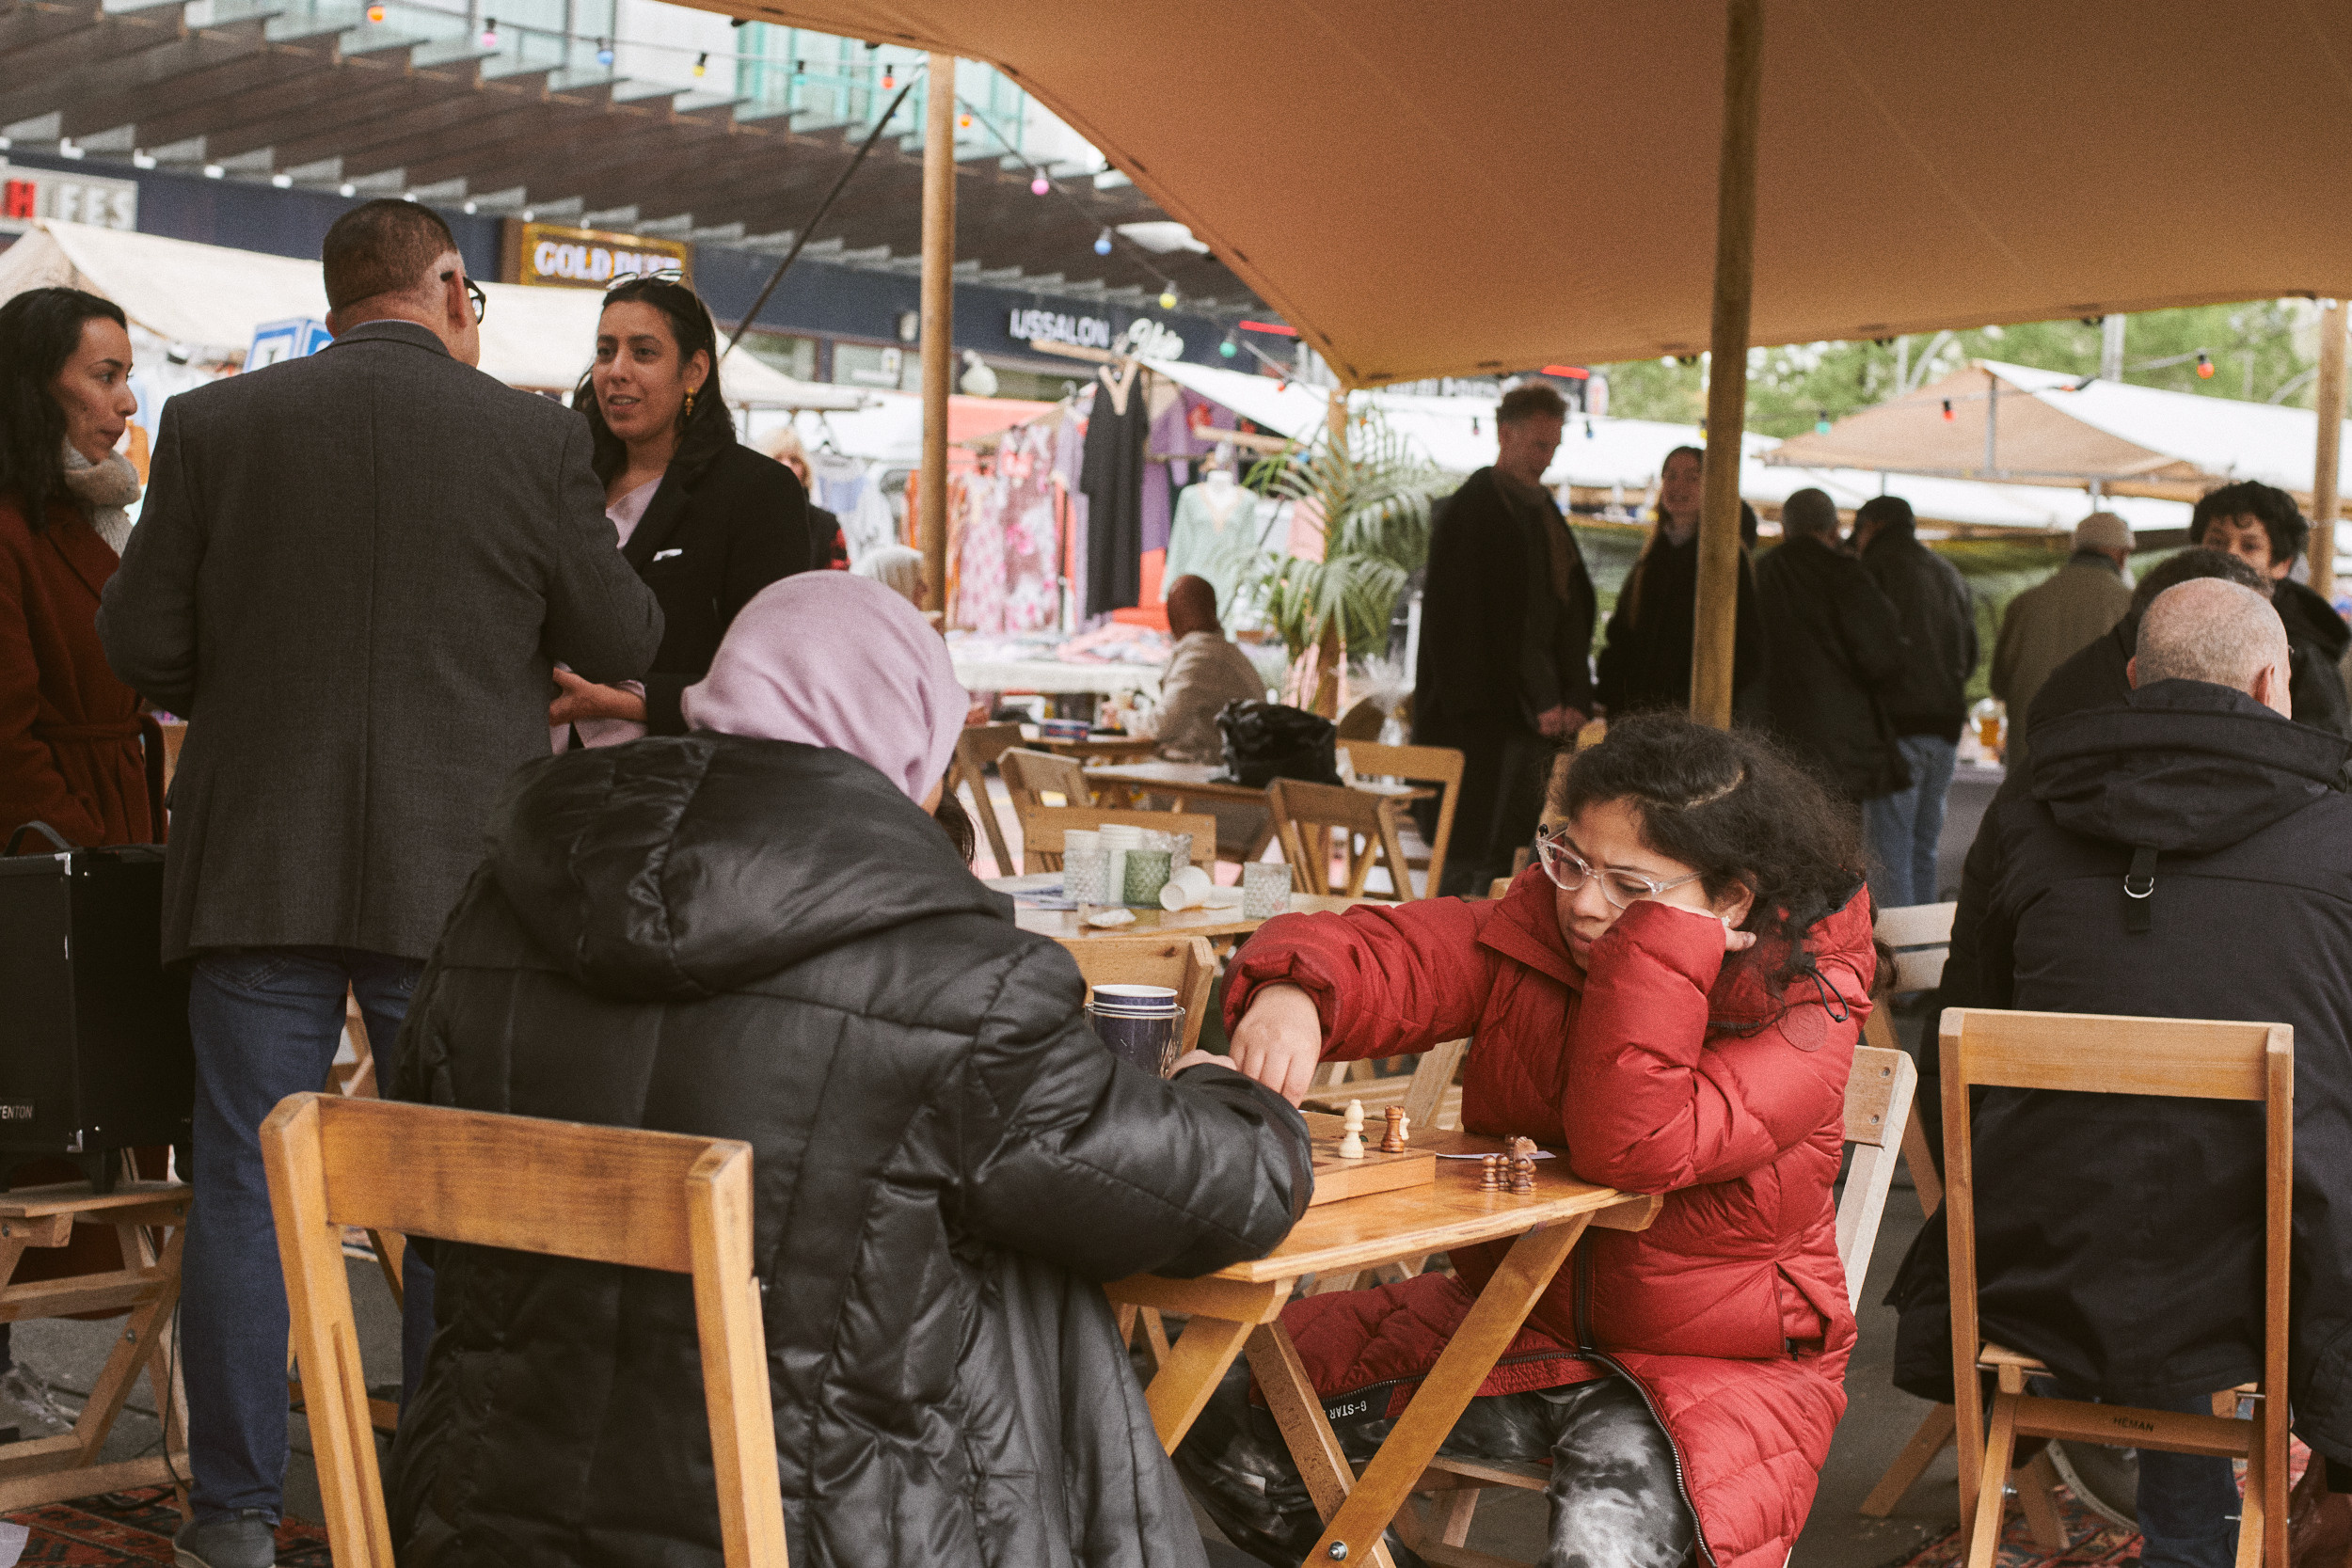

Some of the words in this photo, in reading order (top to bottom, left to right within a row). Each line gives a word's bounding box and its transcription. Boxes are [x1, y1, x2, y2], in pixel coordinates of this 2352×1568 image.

[533, 241, 612, 281] GOLD
[1009, 308, 1110, 348] IJSSALON
[0, 1105, 33, 1119] ENTON
[1329, 1401, 1367, 1419] G-STAR
